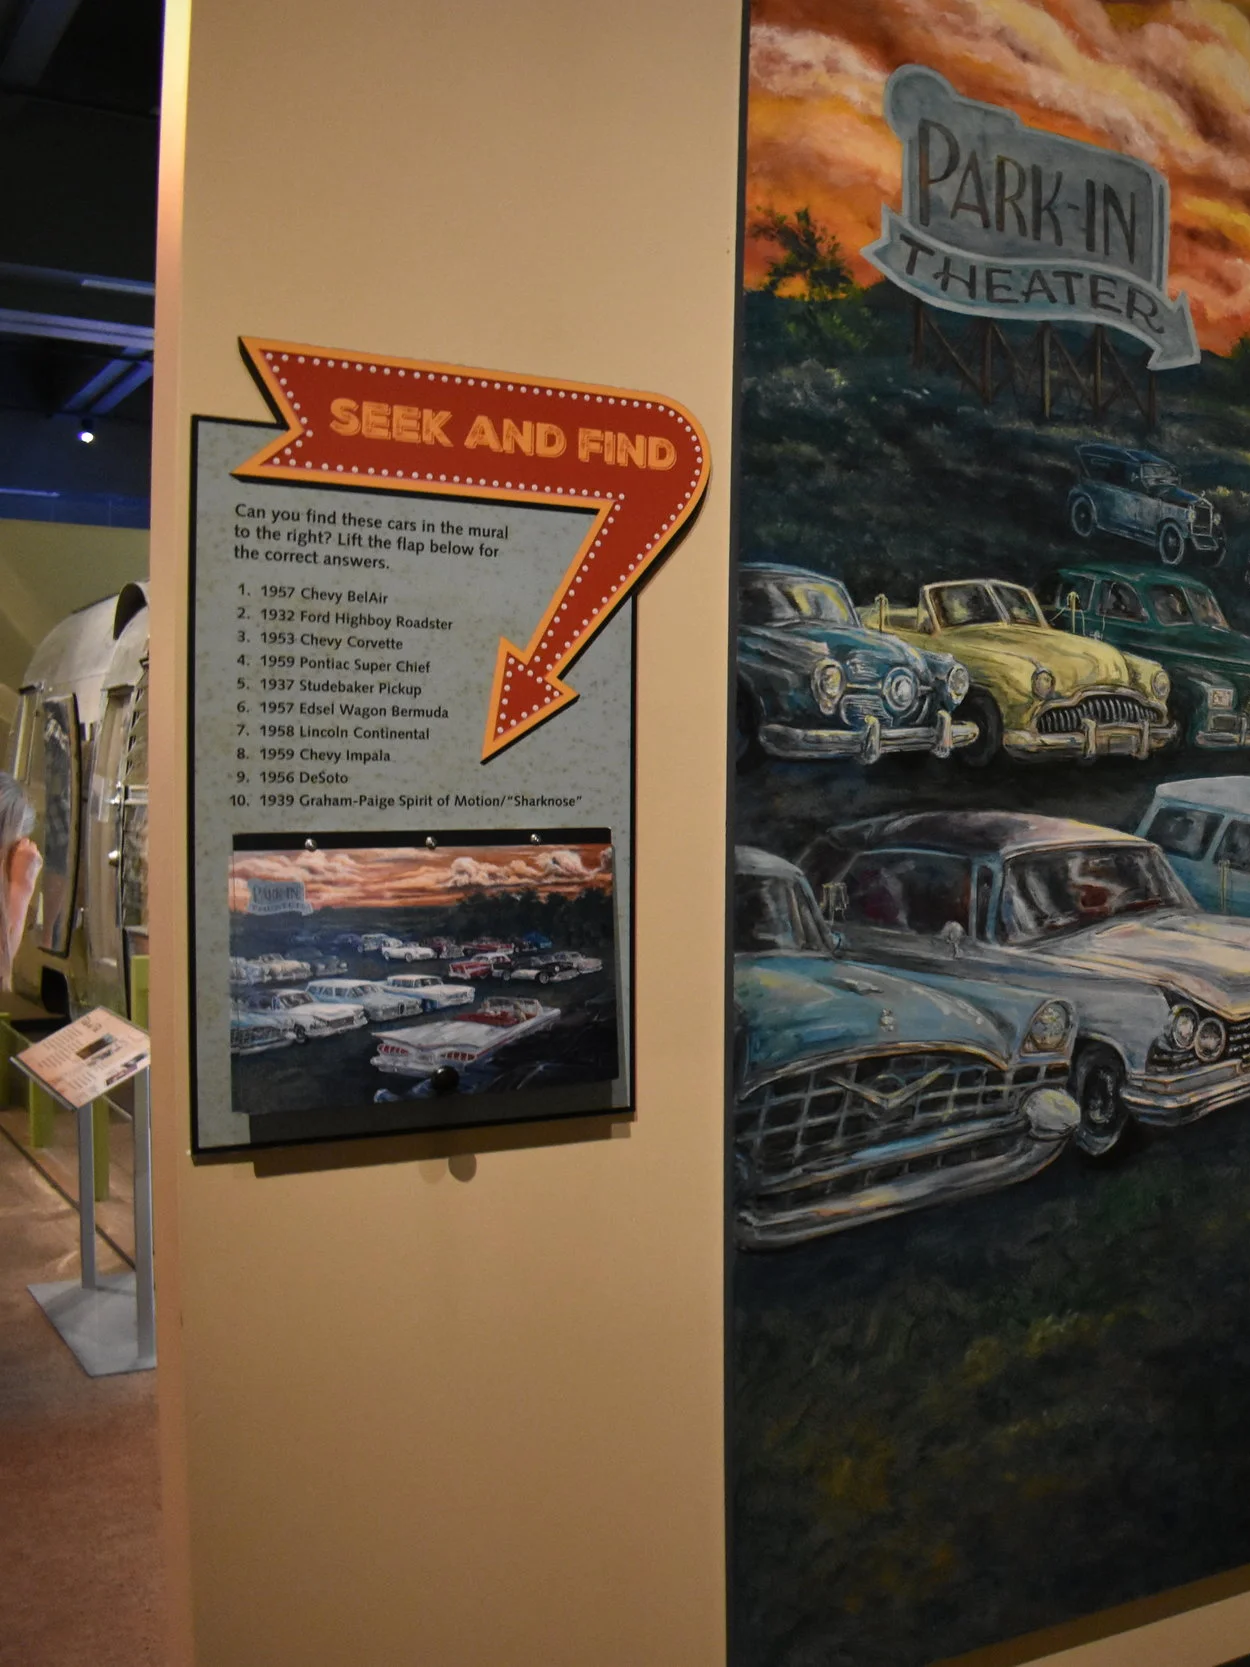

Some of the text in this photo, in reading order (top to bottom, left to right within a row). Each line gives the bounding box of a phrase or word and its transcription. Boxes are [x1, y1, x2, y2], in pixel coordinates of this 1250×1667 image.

[918, 118, 1136, 264] PARK-IN
[899, 233, 1165, 335] THEATER
[329, 396, 677, 471] SEEK AND FIND
[235, 503, 509, 540] Can you find these cars in the mural
[234, 524, 499, 558] to the right? Lift the flap below for
[234, 545, 390, 570] the correct answers.
[238, 584, 388, 605] 1. 1957 Chevy BelAir
[237, 607, 453, 631] 2. 1932 Ford Highboy Roadster
[237, 631, 403, 650] 3. 1953 Chevy Corvette
[237, 654, 431, 674] 4. 1959 Pontiac Super Chief
[237, 678, 422, 698] 5. 1937 Studebaker Pickup
[237, 701, 449, 719] 6. 1957 Edsel Wagon Bermuda
[237, 724, 430, 740] 7. 1958 Lincoln Continental
[237, 748, 391, 764] 8. 1959 Chevy Impala
[236, 771, 348, 784] 9. 1956 DeSoto
[230, 795, 250, 807] 10.
[259, 795, 295, 807] 1939
[300, 794, 395, 809] Graham-Paige
[399, 795, 433, 809] Spirit
[437, 795, 450, 807] of
